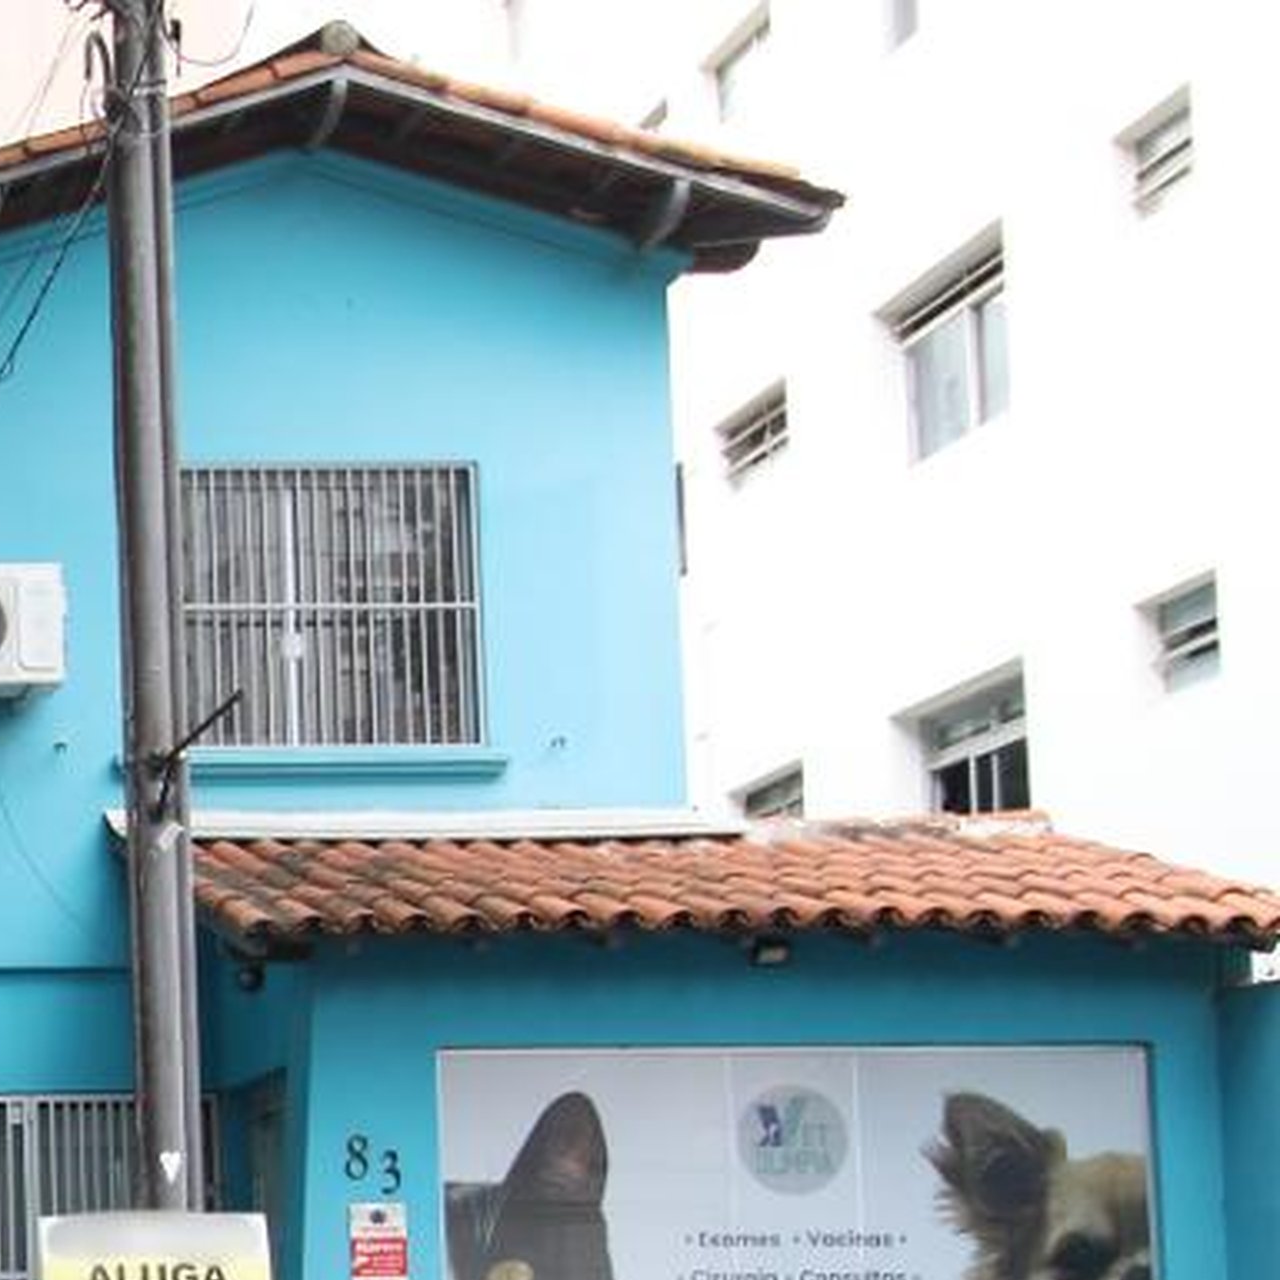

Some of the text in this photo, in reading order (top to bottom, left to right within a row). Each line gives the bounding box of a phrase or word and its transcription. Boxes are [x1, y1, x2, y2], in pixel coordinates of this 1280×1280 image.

[345, 1133, 401, 1195] 83
[698, 1229, 893, 1248] Exames Vacinas
